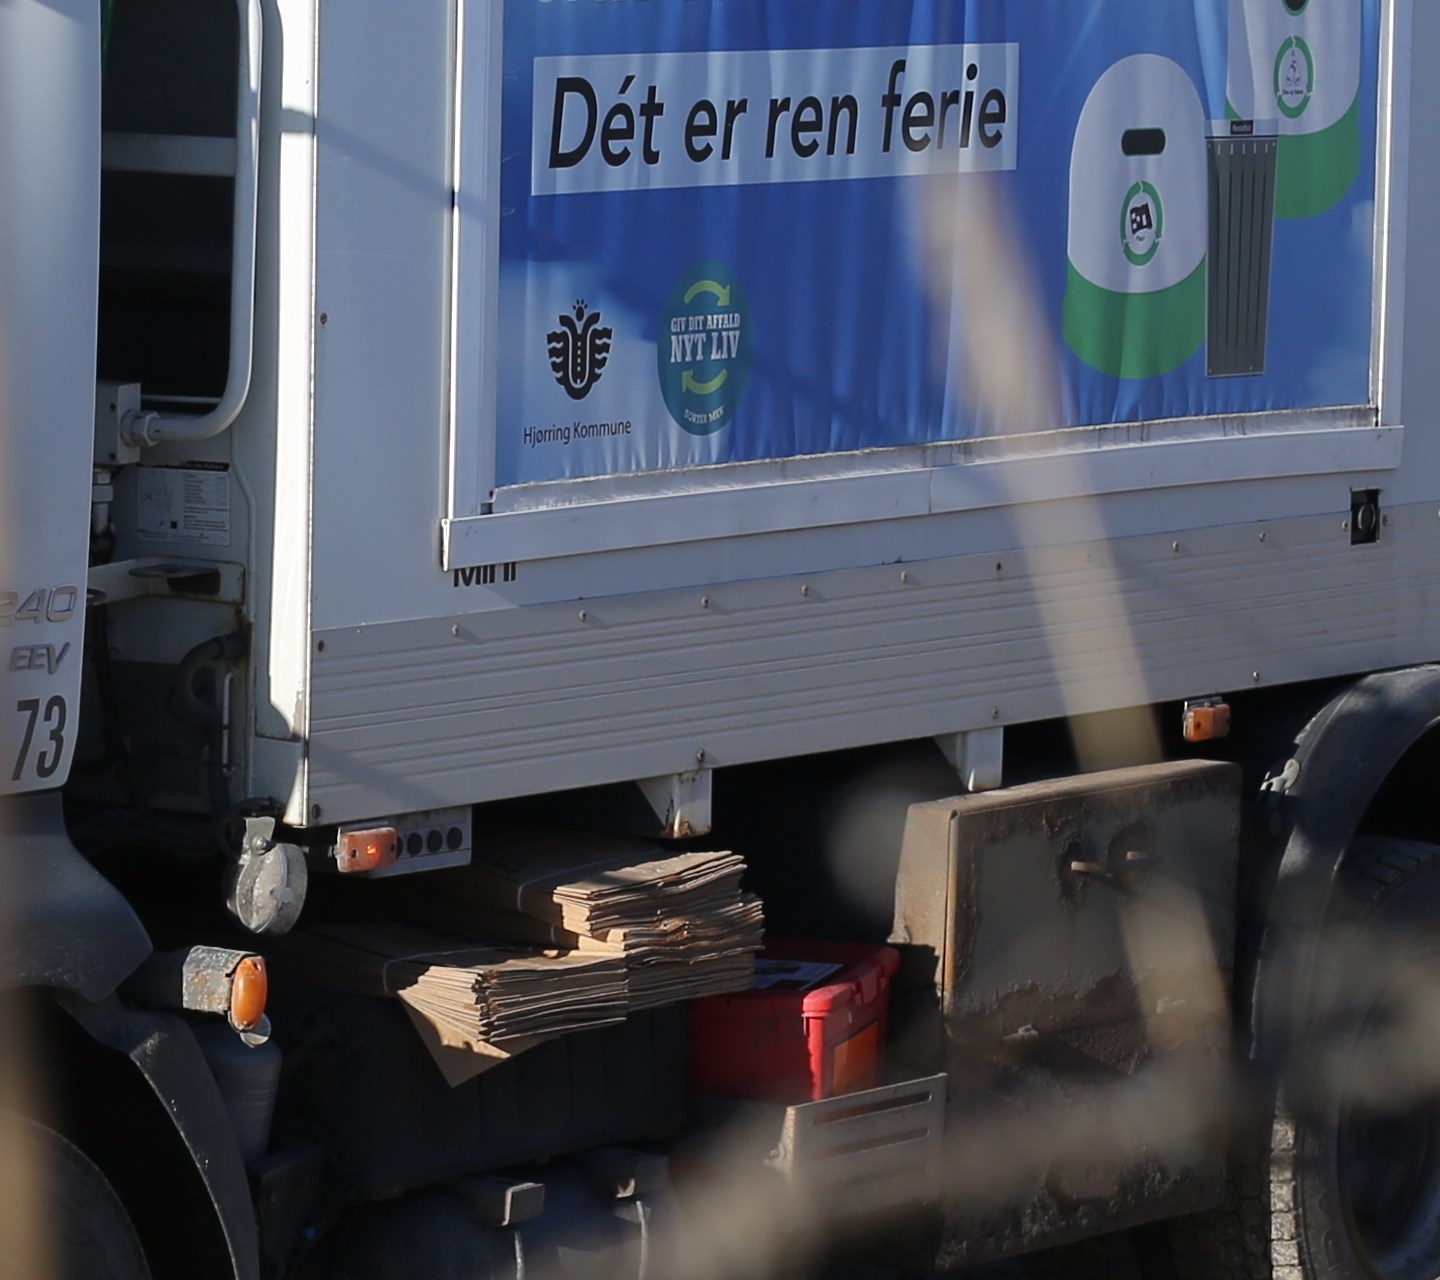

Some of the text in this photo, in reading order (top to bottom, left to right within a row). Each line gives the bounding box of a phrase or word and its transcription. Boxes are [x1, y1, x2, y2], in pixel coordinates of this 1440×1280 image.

[548, 59, 1007, 169] Dét er ren ferie
[671, 313, 741, 332] GIV DIT AFFALD
[670, 330, 741, 363] NYT LIV
[523, 419, 632, 449] Hjørring Kommune
[9, 642, 71, 674] EEV
[11, 695, 67, 781] 73
